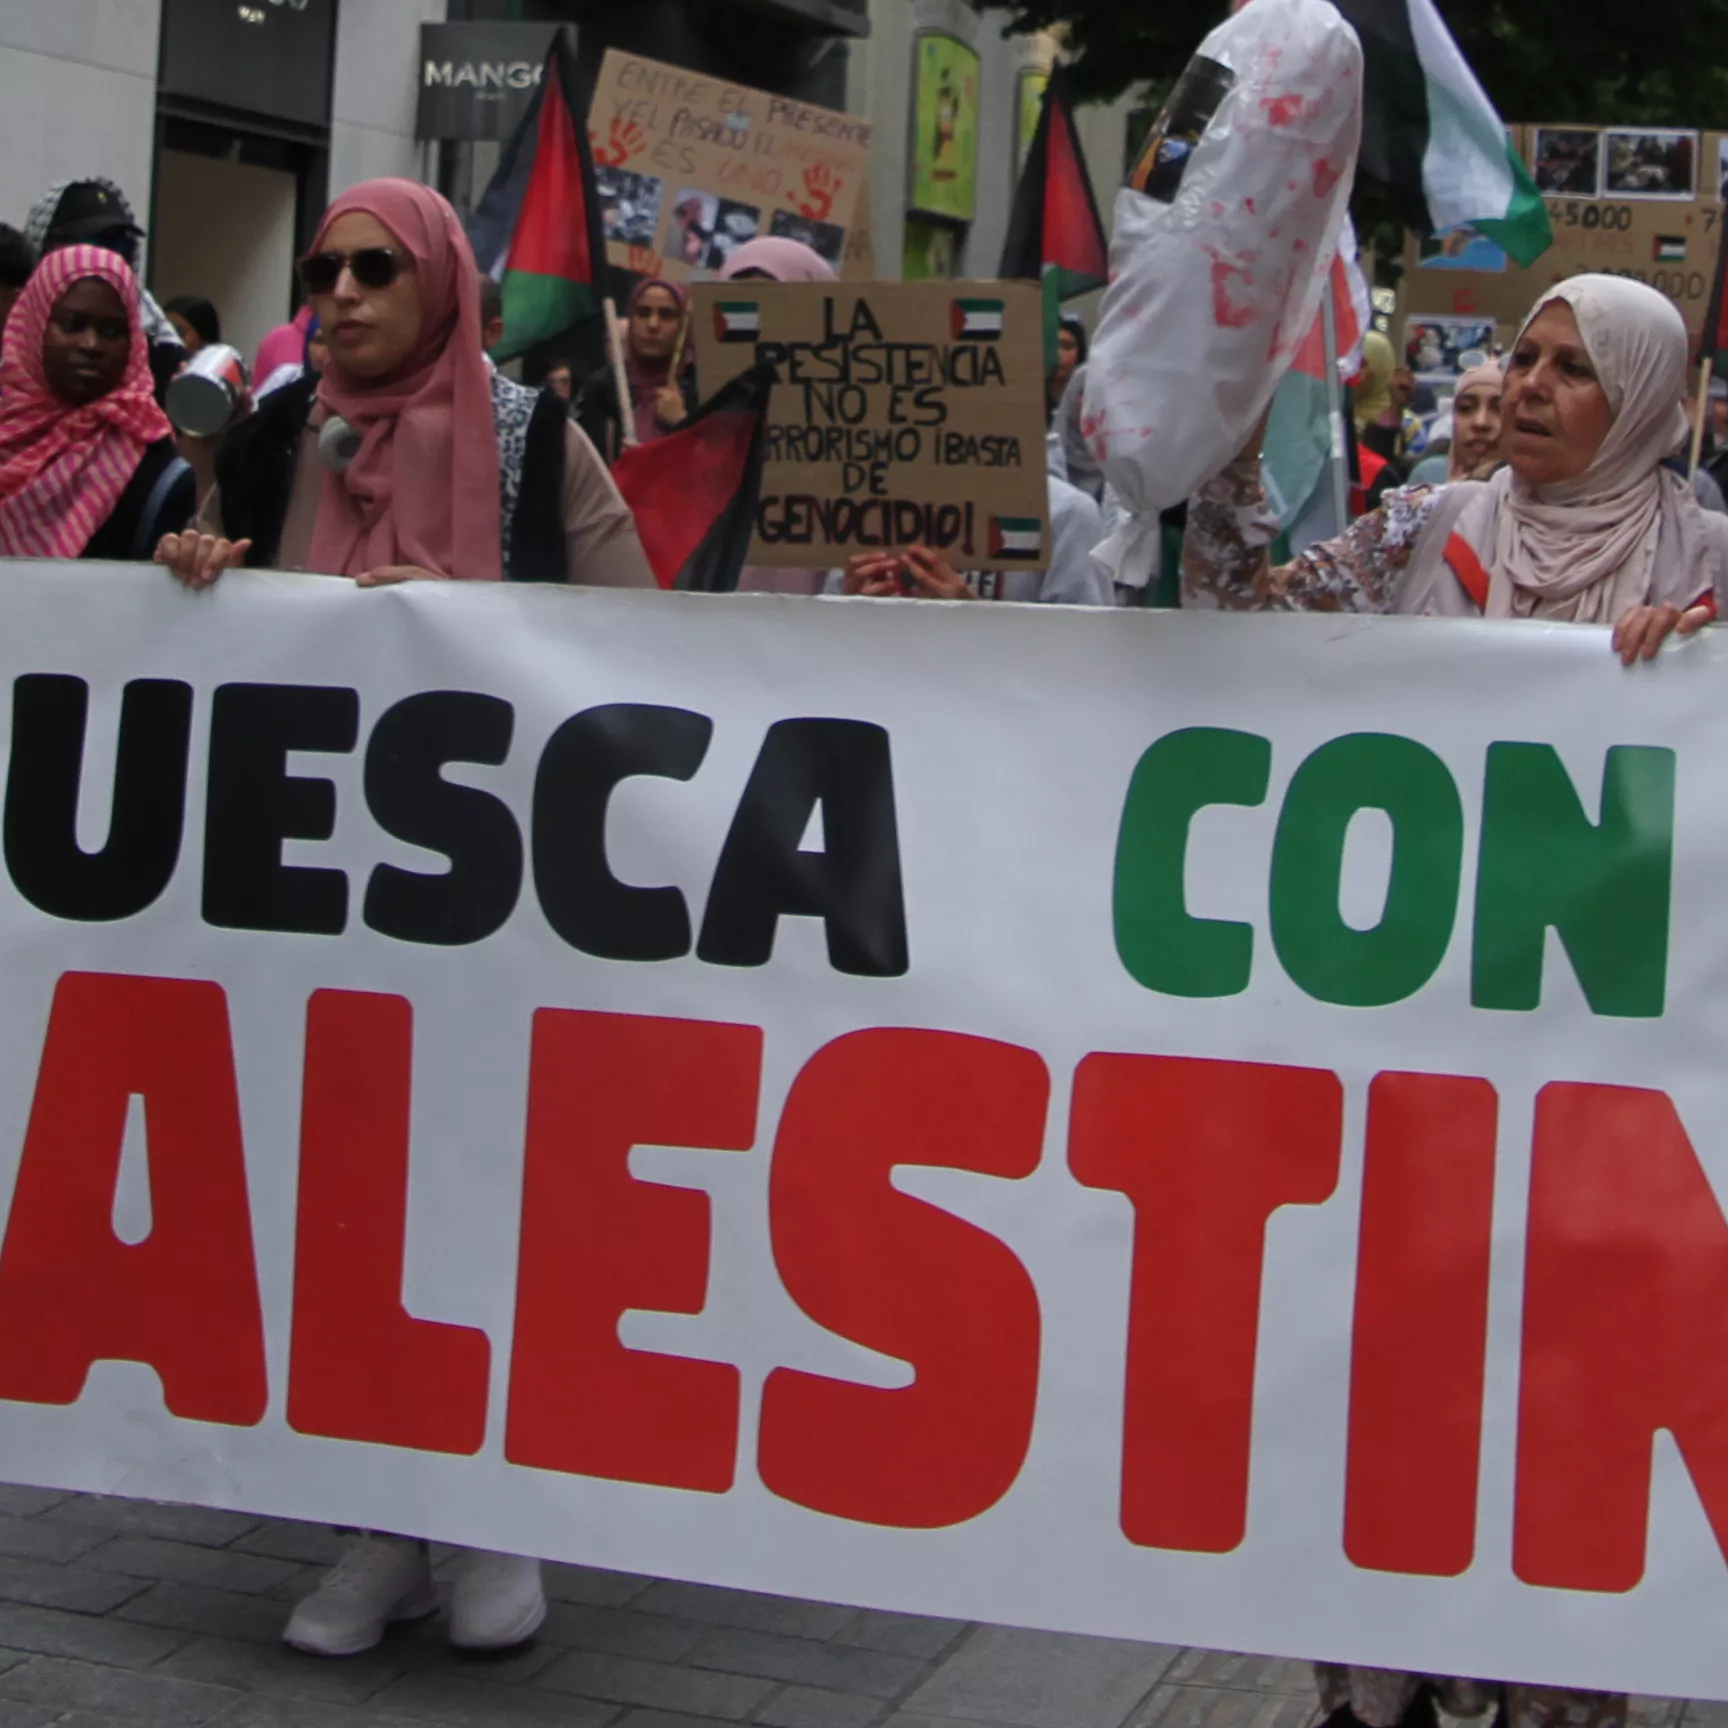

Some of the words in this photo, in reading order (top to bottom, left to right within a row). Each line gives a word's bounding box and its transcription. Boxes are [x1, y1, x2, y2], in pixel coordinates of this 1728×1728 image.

[618, 61, 709, 103] ENTRE
[768, 98, 872, 149] PRESENTE
[650, 139, 696, 175] ES
[823, 297, 883, 343] LA
[755, 341, 1006, 387] RESISTENCIA
[804, 380, 867, 425] NO
[890, 384, 948, 426] ES
[765, 424, 921, 463] RRORISMO
[843, 462, 889, 495] DE
[756, 494, 975, 556] GENOCIDIO!
[1111, 725, 1677, 1019] CON
